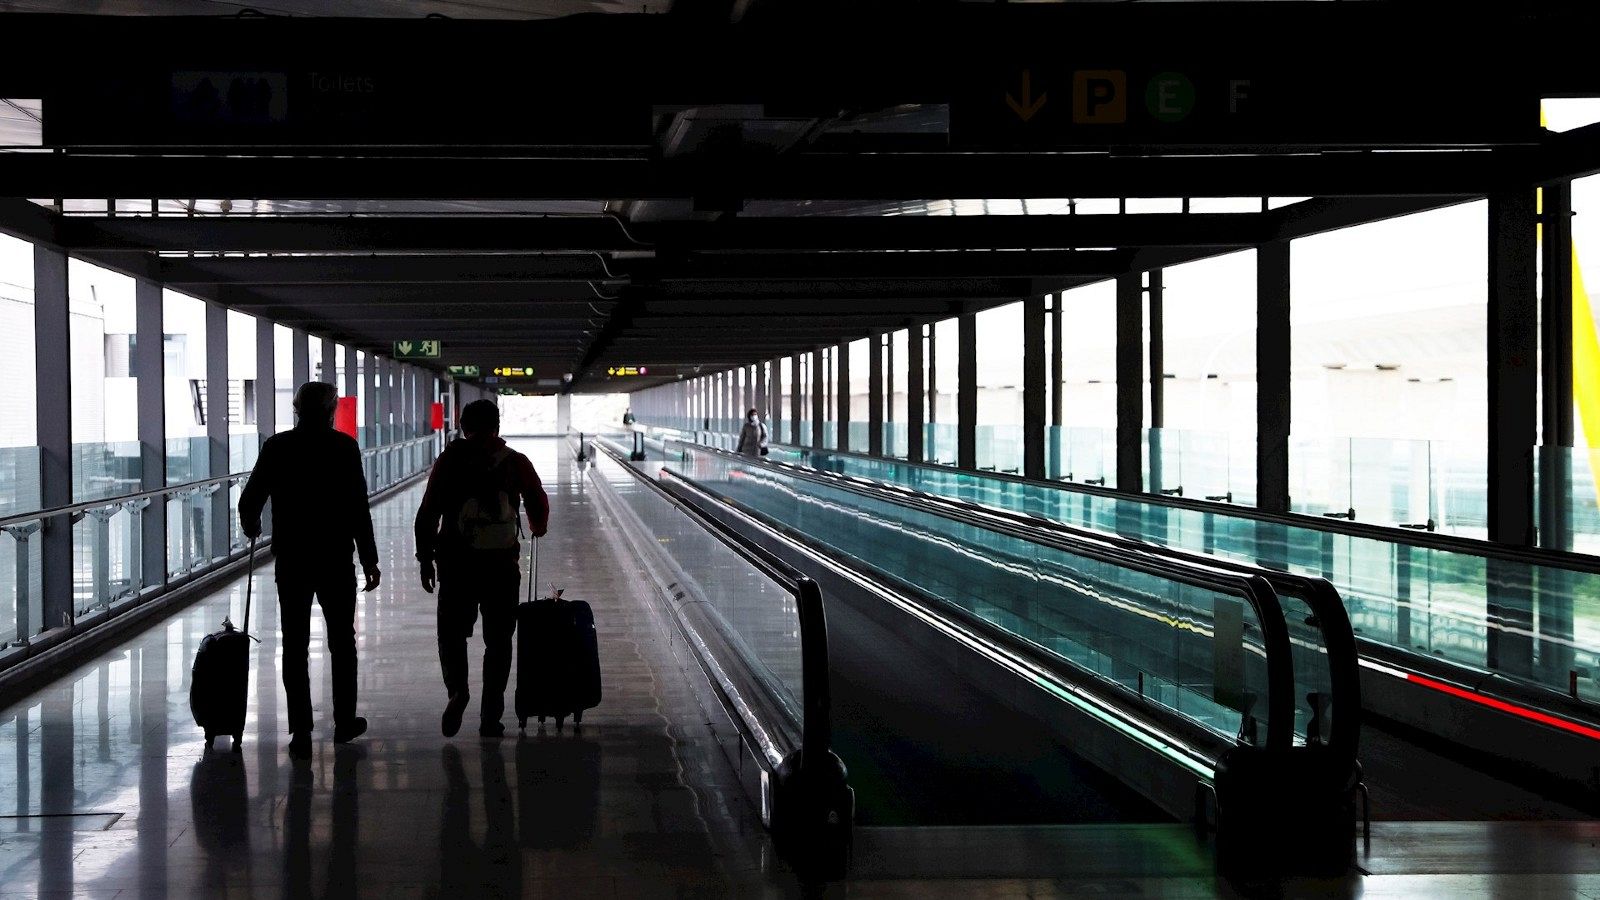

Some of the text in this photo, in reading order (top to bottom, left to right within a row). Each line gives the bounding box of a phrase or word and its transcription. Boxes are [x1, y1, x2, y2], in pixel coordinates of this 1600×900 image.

[307, 72, 374, 92] Toilets
[1086, 78, 1251, 116] P E F
